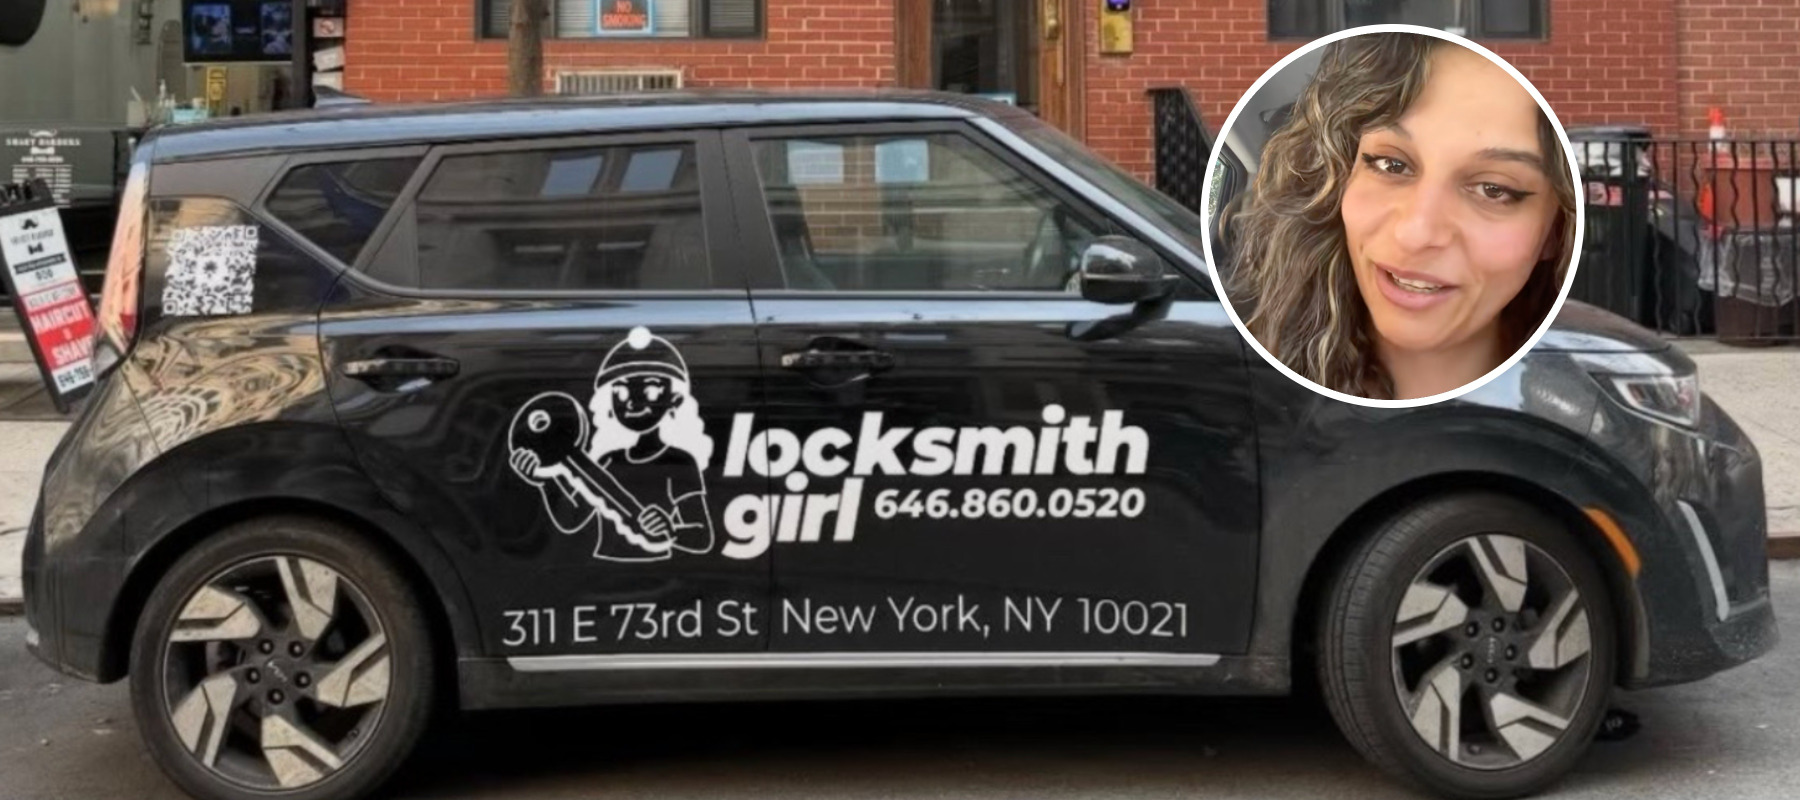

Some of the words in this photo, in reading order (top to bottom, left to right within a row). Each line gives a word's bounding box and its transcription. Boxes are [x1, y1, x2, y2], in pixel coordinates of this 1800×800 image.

[603, 13, 646, 27] SMOKING
[616, 0, 633, 13] NO
[30, 300, 90, 333] HAIRCUT
[723, 403, 1149, 477] locksmith
[721, 471, 864, 559] girl
[874, 488, 1145, 519] 646.860.0520
[503, 609, 556, 646] 311
[573, 605, 598, 643] E
[610, 600, 702, 641] 73rd
[717, 599, 759, 637] St
[782, 598, 876, 634] New
[887, 595, 990, 638] York,
[1004, 597, 1062, 632] NY
[1077, 598, 1187, 637] 10021
